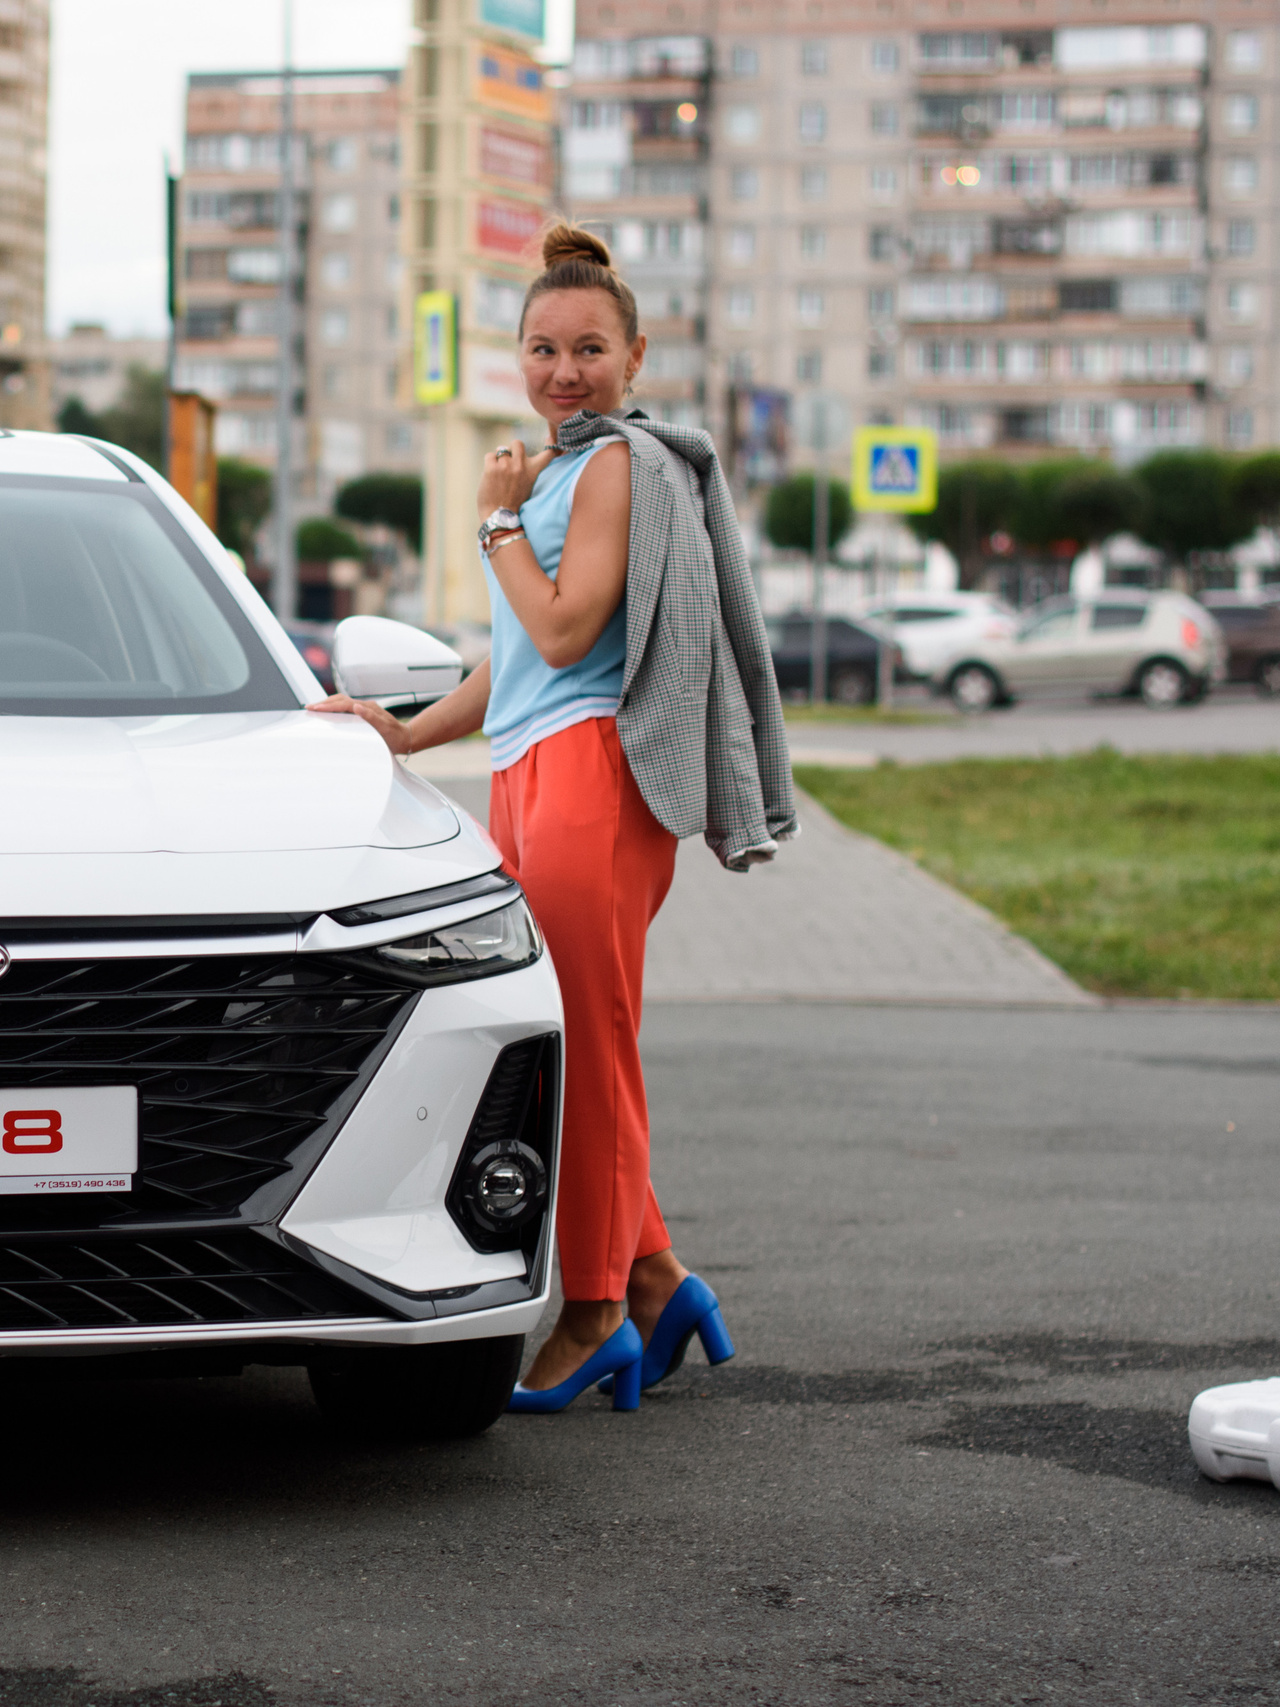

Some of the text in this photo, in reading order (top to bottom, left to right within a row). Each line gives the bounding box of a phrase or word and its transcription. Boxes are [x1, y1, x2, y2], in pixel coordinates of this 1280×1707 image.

[2, 1109, 63, 1154] 8
[48, 1180, 82, 1189] (3519)
[105, 1179, 126, 1187] 436
